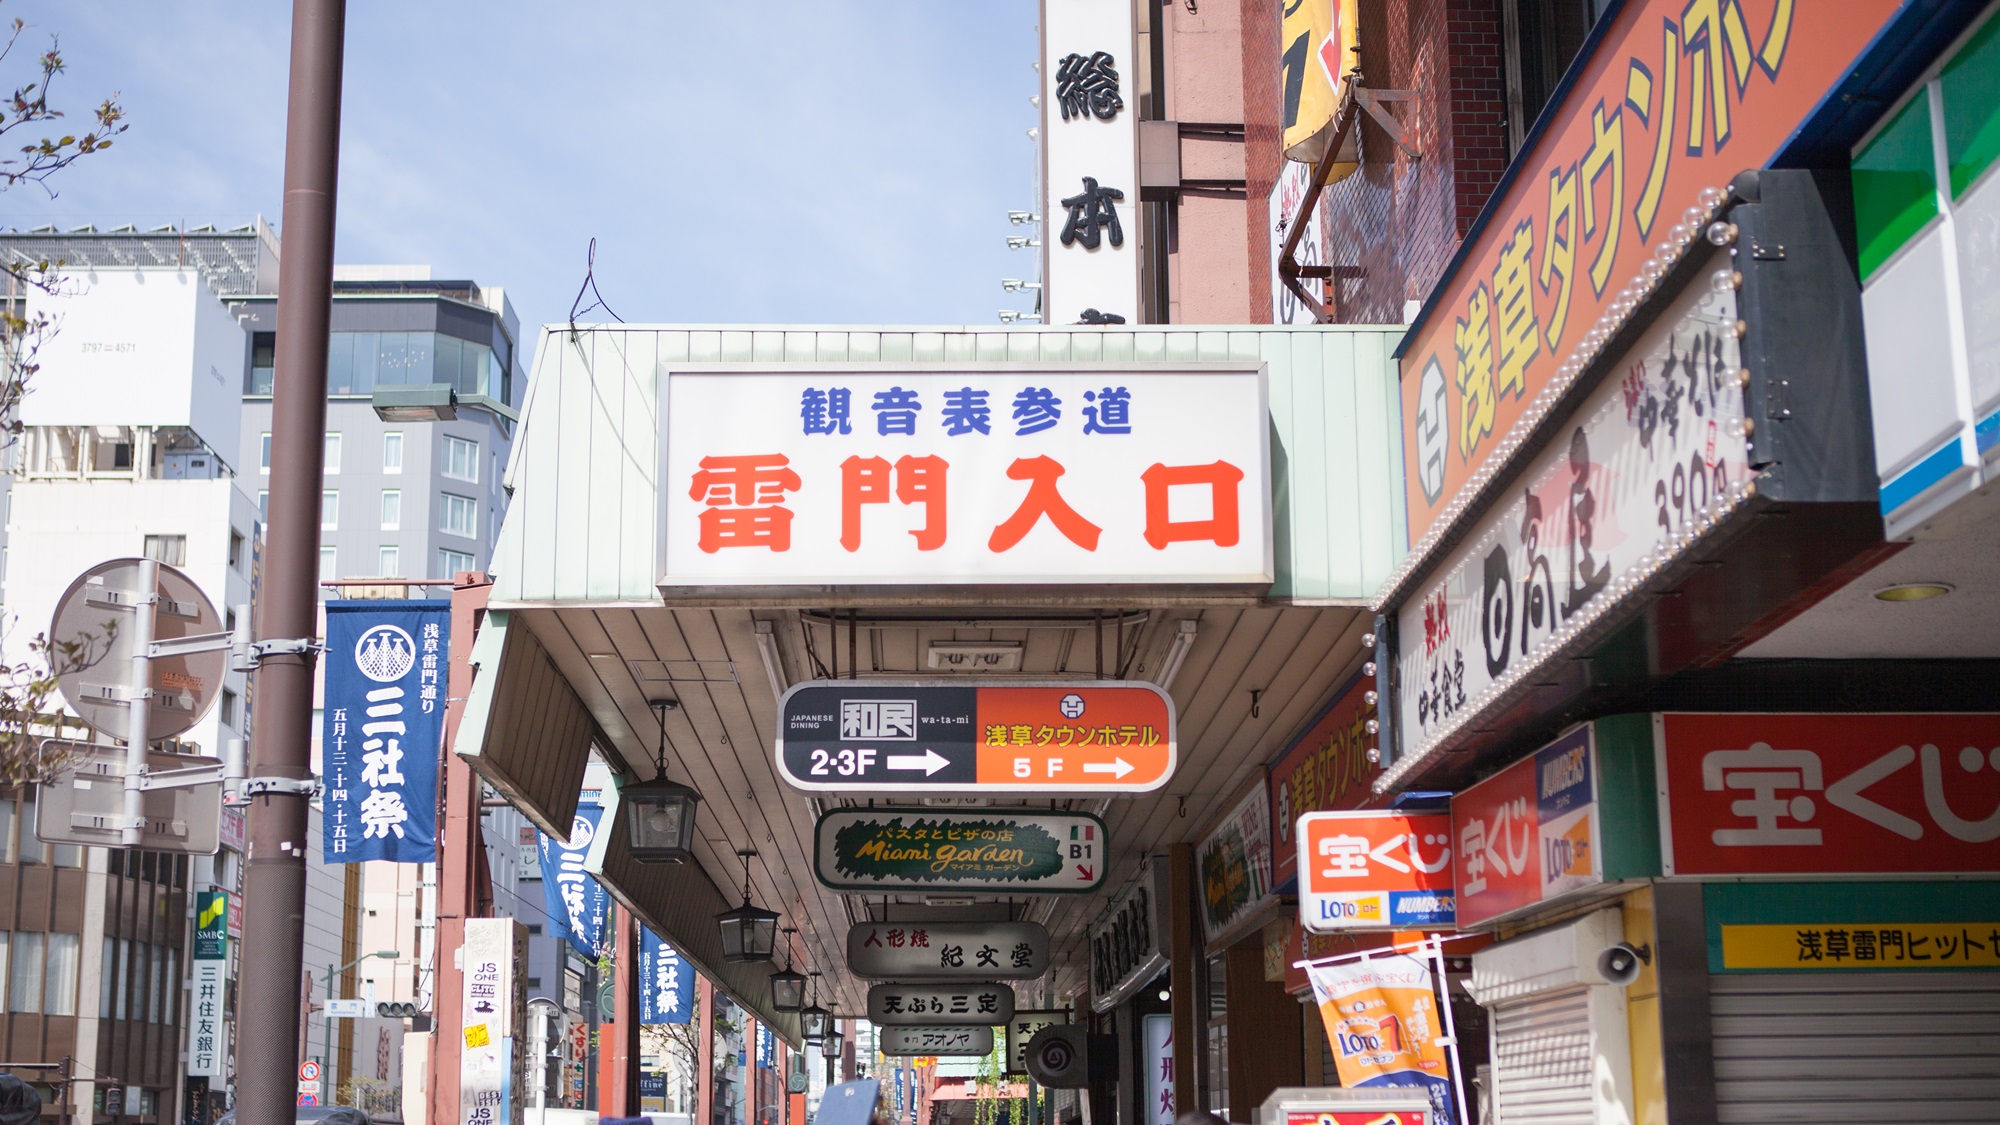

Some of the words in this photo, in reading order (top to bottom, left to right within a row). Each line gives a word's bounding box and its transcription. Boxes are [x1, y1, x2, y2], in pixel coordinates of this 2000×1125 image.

[1055, 50, 1127, 324] 総本
[1454, 0, 1798, 458] 浅草タウンホ
[800, 386, 1133, 437] 観音表参道
[688, 452, 1245, 553] 雷門入口
[420, 623, 439, 714] 浅草雷門通り
[791, 714, 834, 722] JAPANESE
[844, 703, 913, 737] 和民
[921, 715, 969, 724] wa-ta-mi
[984, 724, 1160, 748] 浅草タウンホテル
[361, 686, 408, 839] 三社祭
[1702, 742, 2000, 846] 宝くじ
[877, 829, 1014, 841] パスタとピザの店
[1460, 796, 1530, 897] 宝くじ
[855, 841, 931, 861] Miami
[1070, 844, 1093, 859] B1
[1319, 834, 1451, 878] 宝くじ
[1545, 837, 1572, 884] LOTO
[1321, 900, 1356, 920] LOTO
[197, 930, 225, 939] SMBC
[864, 929, 929, 949] 人形焼
[477, 962, 497, 973] JS
[941, 942, 1033, 968] 紀文堂
[474, 973, 500, 981] ONE
[656, 943, 679, 1014] 三社祭
[197, 966, 216, 1070] 三井住友銀行
[883, 993, 999, 1014] 天ぷら三定
[575, 1023, 587, 1063] くすり
[922, 1033, 970, 1047] アオノヤ
[1338, 1033, 1379, 1056] LOTO
[1378, 1014, 1402, 1053] 7
[471, 1108, 491, 1119] JS
